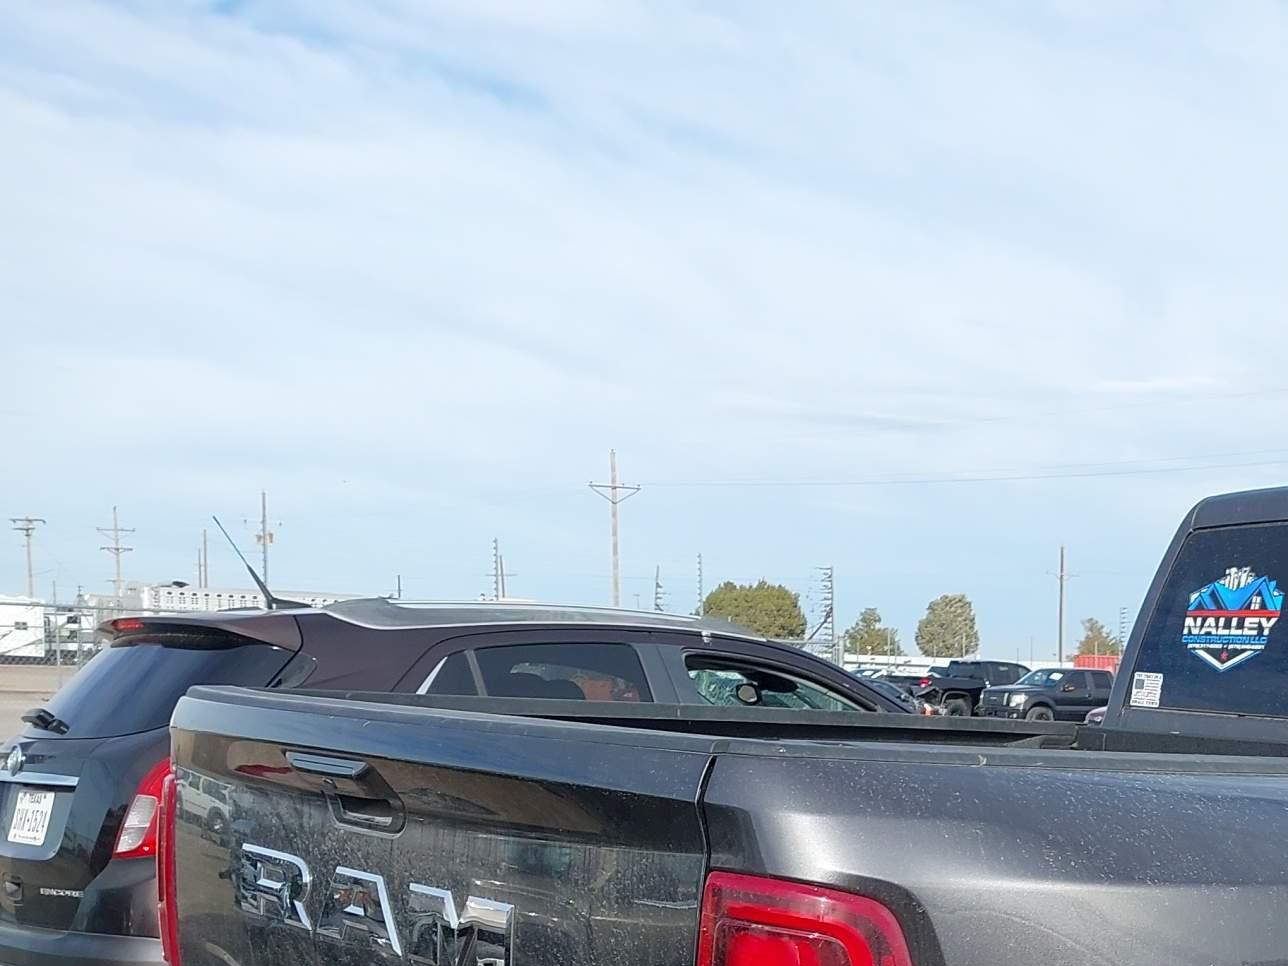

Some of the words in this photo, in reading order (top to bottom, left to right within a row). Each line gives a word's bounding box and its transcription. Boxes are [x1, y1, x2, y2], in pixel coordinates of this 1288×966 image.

[1182, 617, 1280, 635] NALLEY
[1182, 635, 1249, 644] CONSTRUCTION
[40, 887, 85, 898] ENCORE
